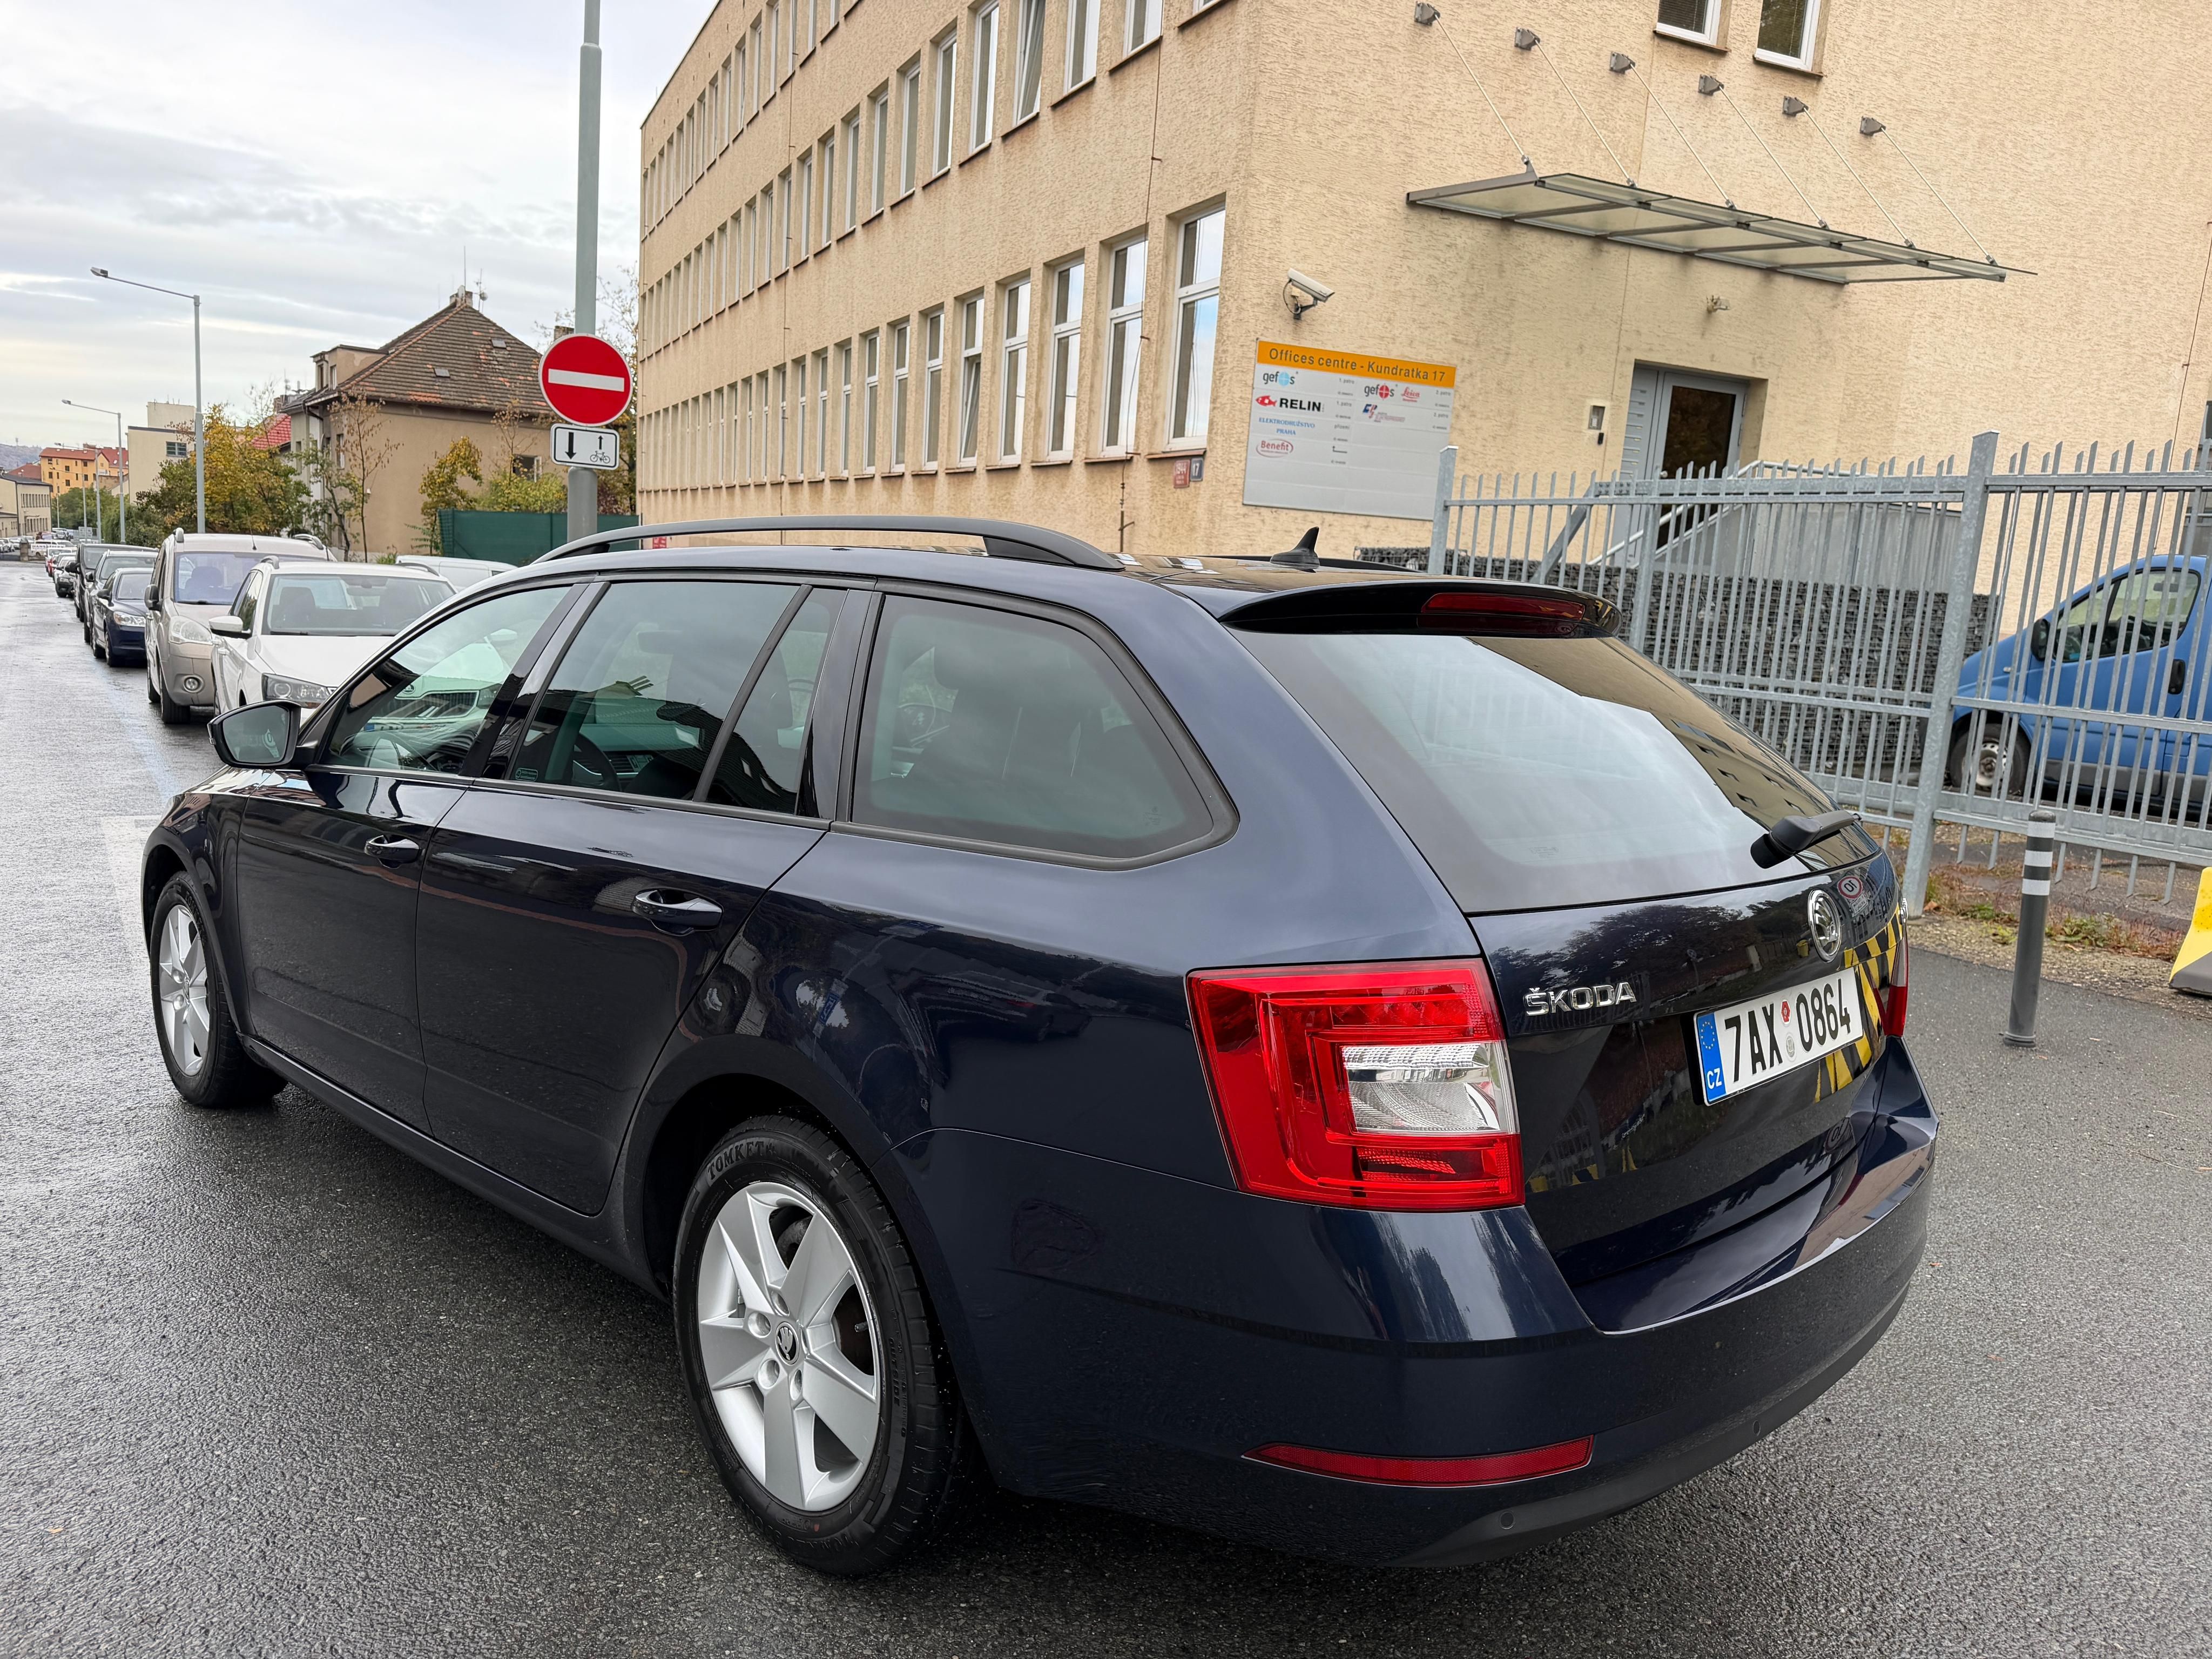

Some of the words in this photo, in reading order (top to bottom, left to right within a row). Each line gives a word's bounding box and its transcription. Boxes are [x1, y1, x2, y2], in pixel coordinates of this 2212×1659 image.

[1270, 348, 1314, 365] Offices
[1318, 358, 1357, 370] centre
[1367, 361, 1428, 380] Kundratka
[1433, 370, 1445, 382] 17
[1401, 387, 1420, 399] Leica
[1279, 398, 1321, 412] RELIN
[1259, 417, 1315, 428] ELEKTRODRUŽSTVO
[1260, 440, 1289, 451] Benefit
[1193, 463, 1199, 476] 17
[1523, 982, 1637, 1016] ŠKODA
[1724, 1003, 1783, 1083] 7AX
[1796, 979, 1851, 1052] 0864
[1707, 1067, 1722, 1090] CZ
[708, 1141, 764, 1180] TOMKET
